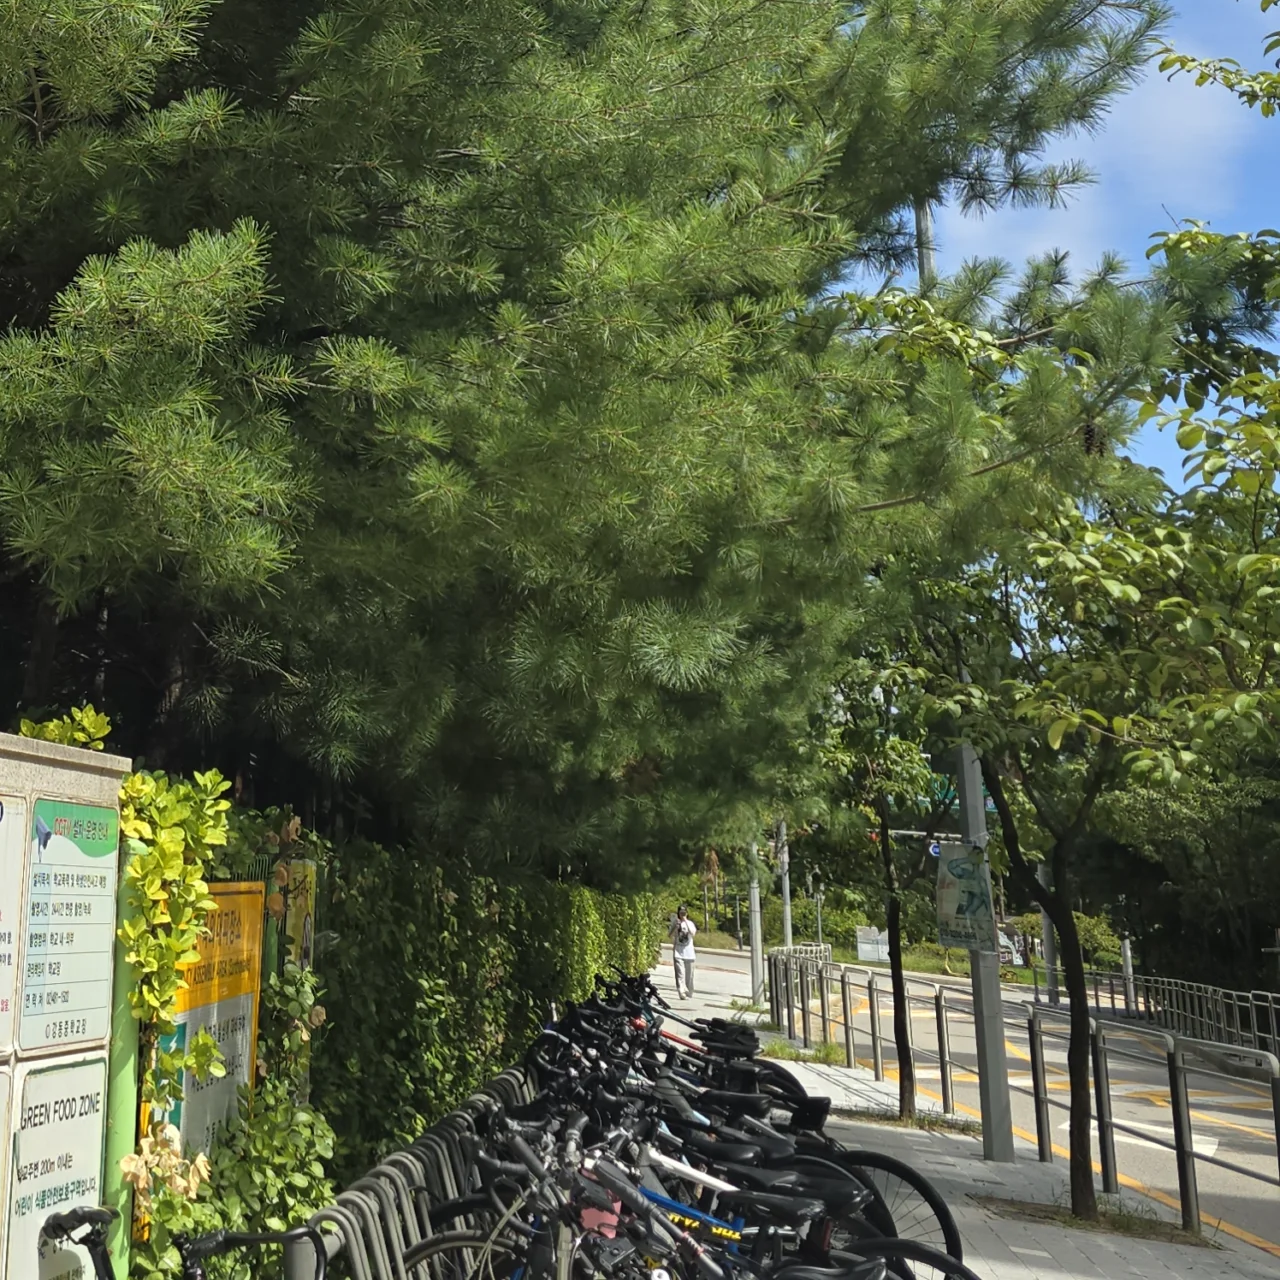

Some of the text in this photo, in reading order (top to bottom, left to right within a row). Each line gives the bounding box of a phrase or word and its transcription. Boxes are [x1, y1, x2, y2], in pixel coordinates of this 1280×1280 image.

[54, 816, 72, 836] CCTV
[98, 821, 108, 841] 안내
[33, 872, 50, 887] 설치목적
[53, 873, 70, 887] 학교폭력
[31, 901, 48, 916] 촬영시간
[50, 932, 58, 945] 학교
[48, 961, 61, 976] 학교장
[52, 1019, 86, 1038] 강동중학교장
[20, 1091, 101, 1130] GREEN FOOD ZONE
[14, 1193, 34, 1218] 어린이
